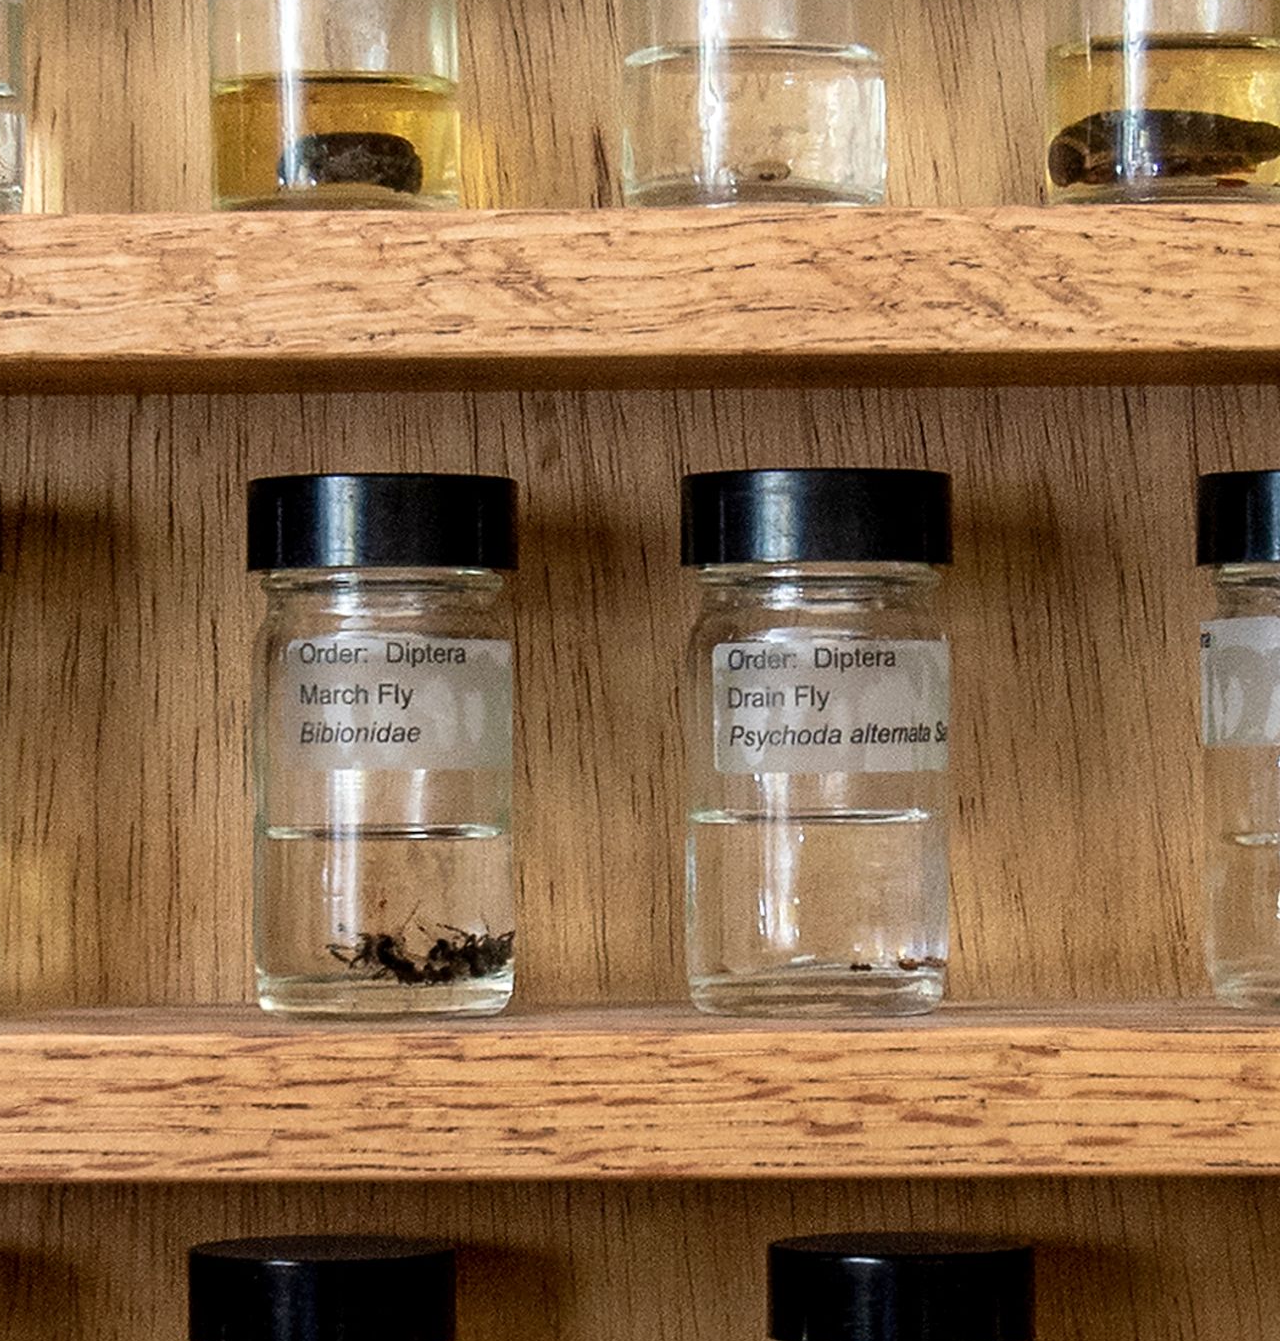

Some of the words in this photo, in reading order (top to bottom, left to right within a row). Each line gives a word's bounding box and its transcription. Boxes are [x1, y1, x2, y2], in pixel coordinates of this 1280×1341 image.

[300, 642, 368, 665] Order:
[386, 641, 467, 668] Diptera
[728, 648, 798, 672] Order:
[814, 647, 897, 674] Diptera
[300, 683, 369, 706] March
[378, 682, 414, 710] Fly
[727, 686, 785, 709] Drain
[794, 685, 831, 711] Fly
[300, 721, 422, 744] Bibionidae
[730, 723, 842, 752] Psychoda
[850, 720, 931, 745] alternata
